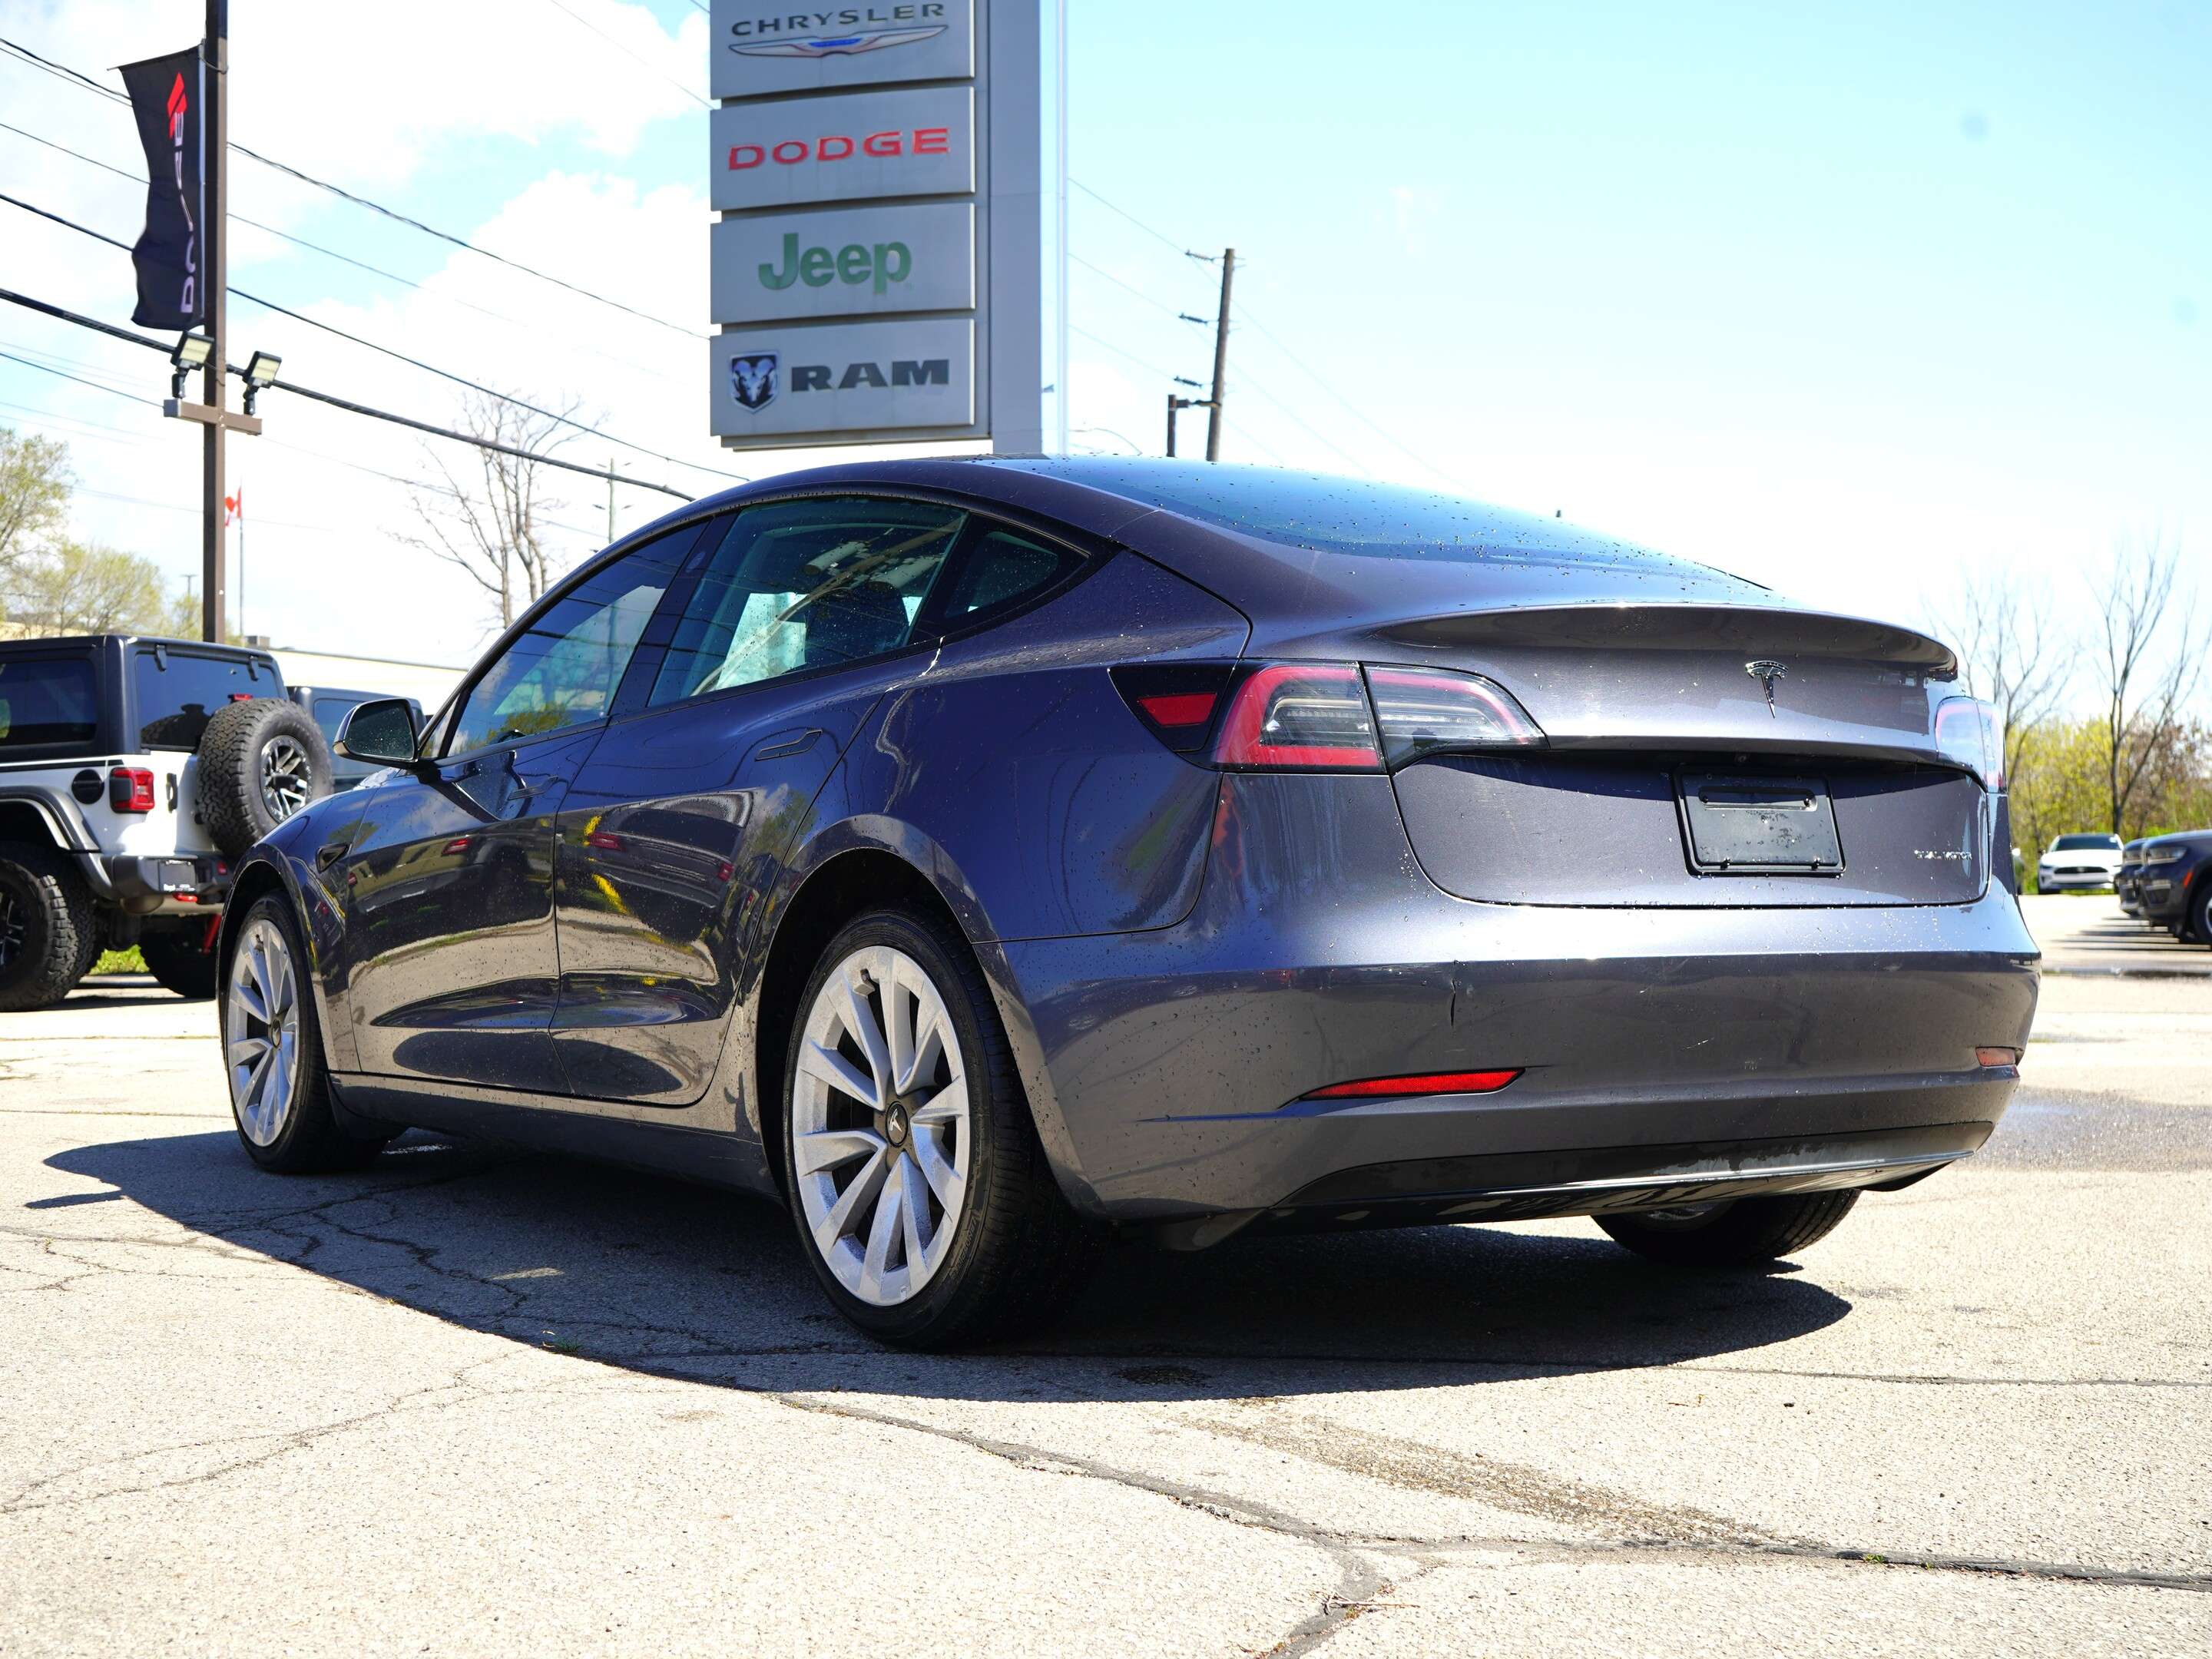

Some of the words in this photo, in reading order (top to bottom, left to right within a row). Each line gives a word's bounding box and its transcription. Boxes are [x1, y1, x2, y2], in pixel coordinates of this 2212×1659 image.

[731, 3, 944, 36] CHRYSLER
[729, 127, 950, 171] DODGE
[758, 233, 912, 294] Jeep
[790, 359, 949, 392] RAM
